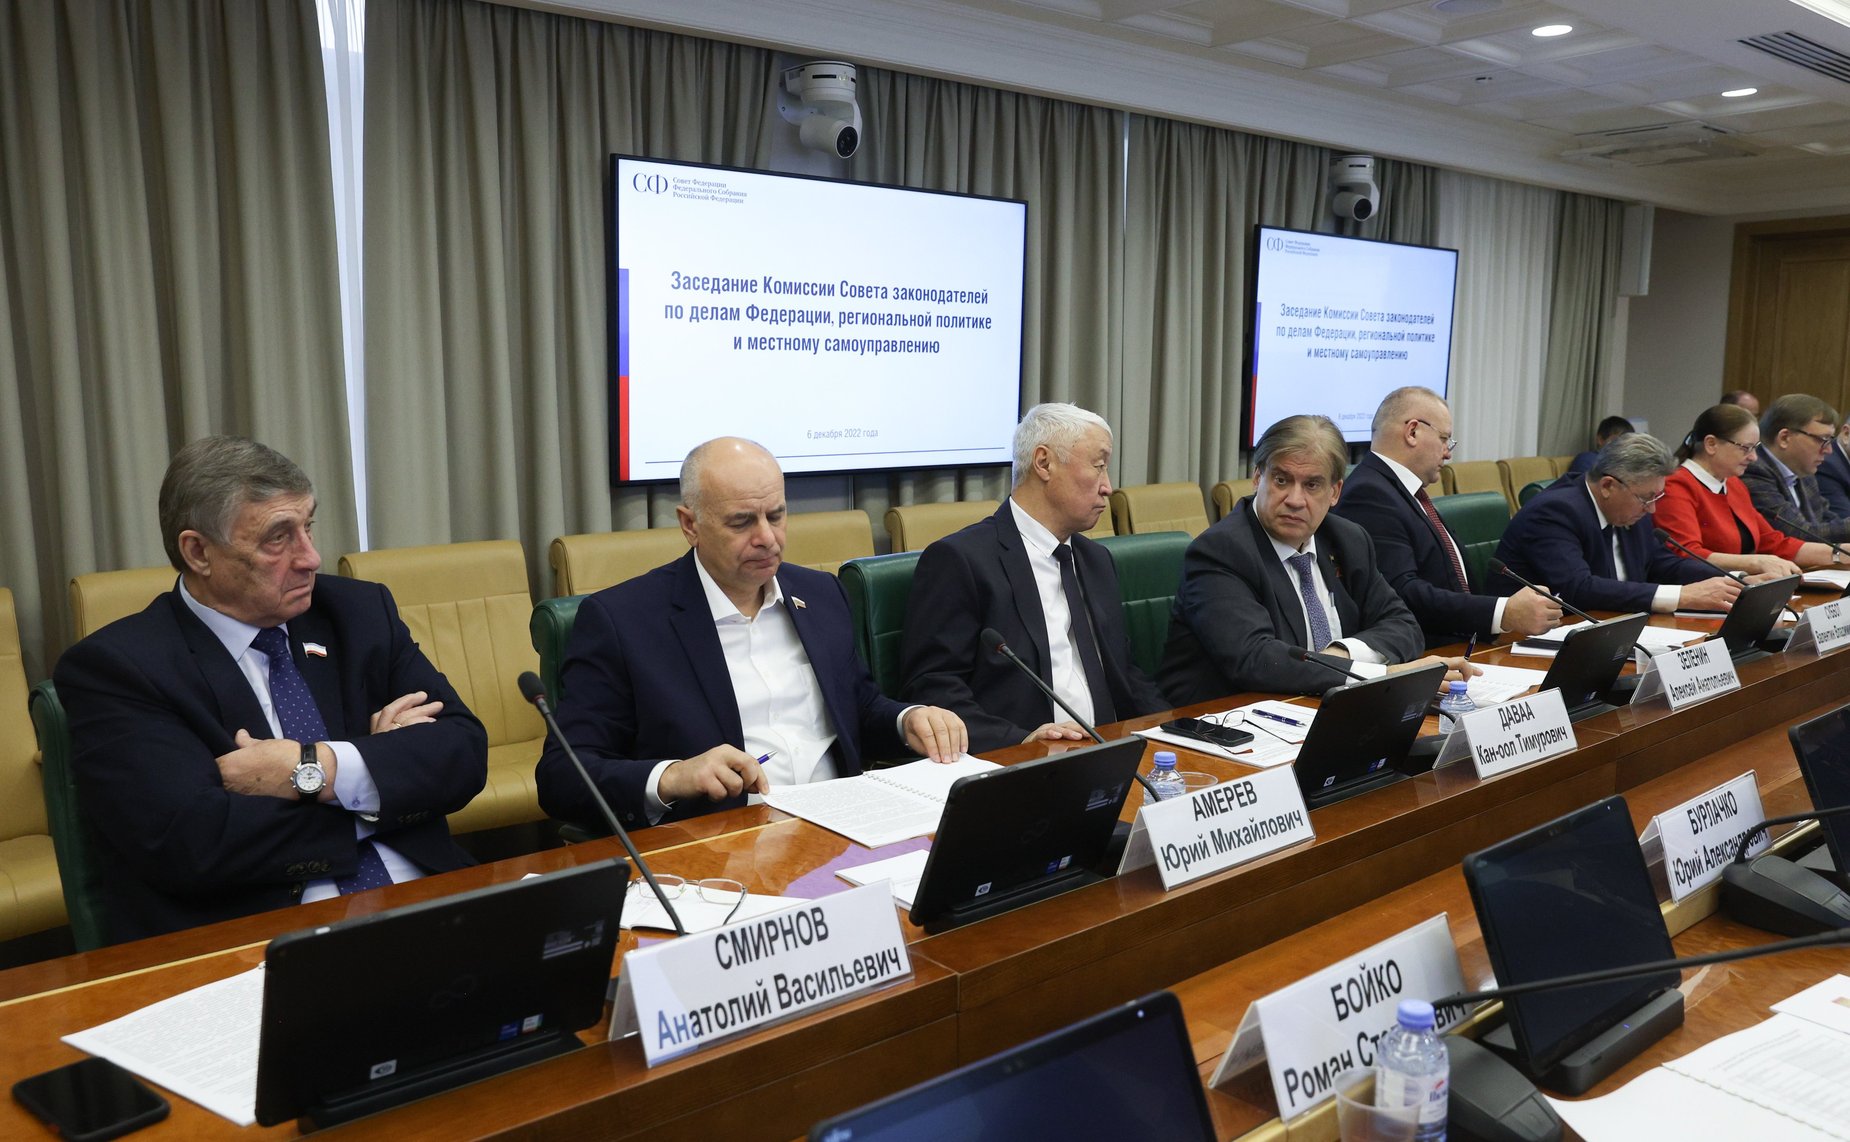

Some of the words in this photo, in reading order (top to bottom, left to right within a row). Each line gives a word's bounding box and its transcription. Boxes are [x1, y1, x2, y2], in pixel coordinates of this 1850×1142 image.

[633, 172, 668, 195] СФ
[671, 270, 758, 294] Заседание
[763, 276, 835, 297] Комиссии
[840, 280, 888, 300] Совета
[892, 286, 988, 305] законодателей
[664, 304, 684, 319] по
[689, 305, 741, 323] делам
[745, 303, 834, 327] Федерации,
[838, 310, 932, 328] региональной
[936, 314, 992, 330] политике
[1280, 303, 1322, 319] Заседание
[1324, 305, 1359, 320] Комиссии
[1361, 308, 1385, 322] Совета
[733, 336, 742, 350] и
[747, 336, 820, 355] местному
[824, 337, 940, 356] самоуправлению
[1276, 326, 1286, 337] по
[1288, 327, 1312, 339] делам
[1314, 347, 1349, 361] местному
[813, 429, 843, 440] декабря
[844, 428, 861, 438] 2022
[863, 429, 879, 438] года
[1498, 701, 1535, 731] ДАВАА
[1476, 741, 1517, 765] Кан-оол
[1515, 726, 1568, 753] Тимурович
[1192, 780, 1258, 821] АМЕРЕВ
[1687, 790, 1738, 835] БУРЛАЧКО
[1160, 833, 1211, 872] Юрий
[1210, 809, 1304, 855] Михайлович
[1672, 848, 1705, 888] Юрий
[715, 906, 829, 970] СМИРНОВ
[657, 978, 772, 1049] Анатолий
[773, 947, 902, 1009] Васильевич
[1330, 959, 1402, 1021] БОЙКО
[1283, 1049, 1354, 1108] Роман
